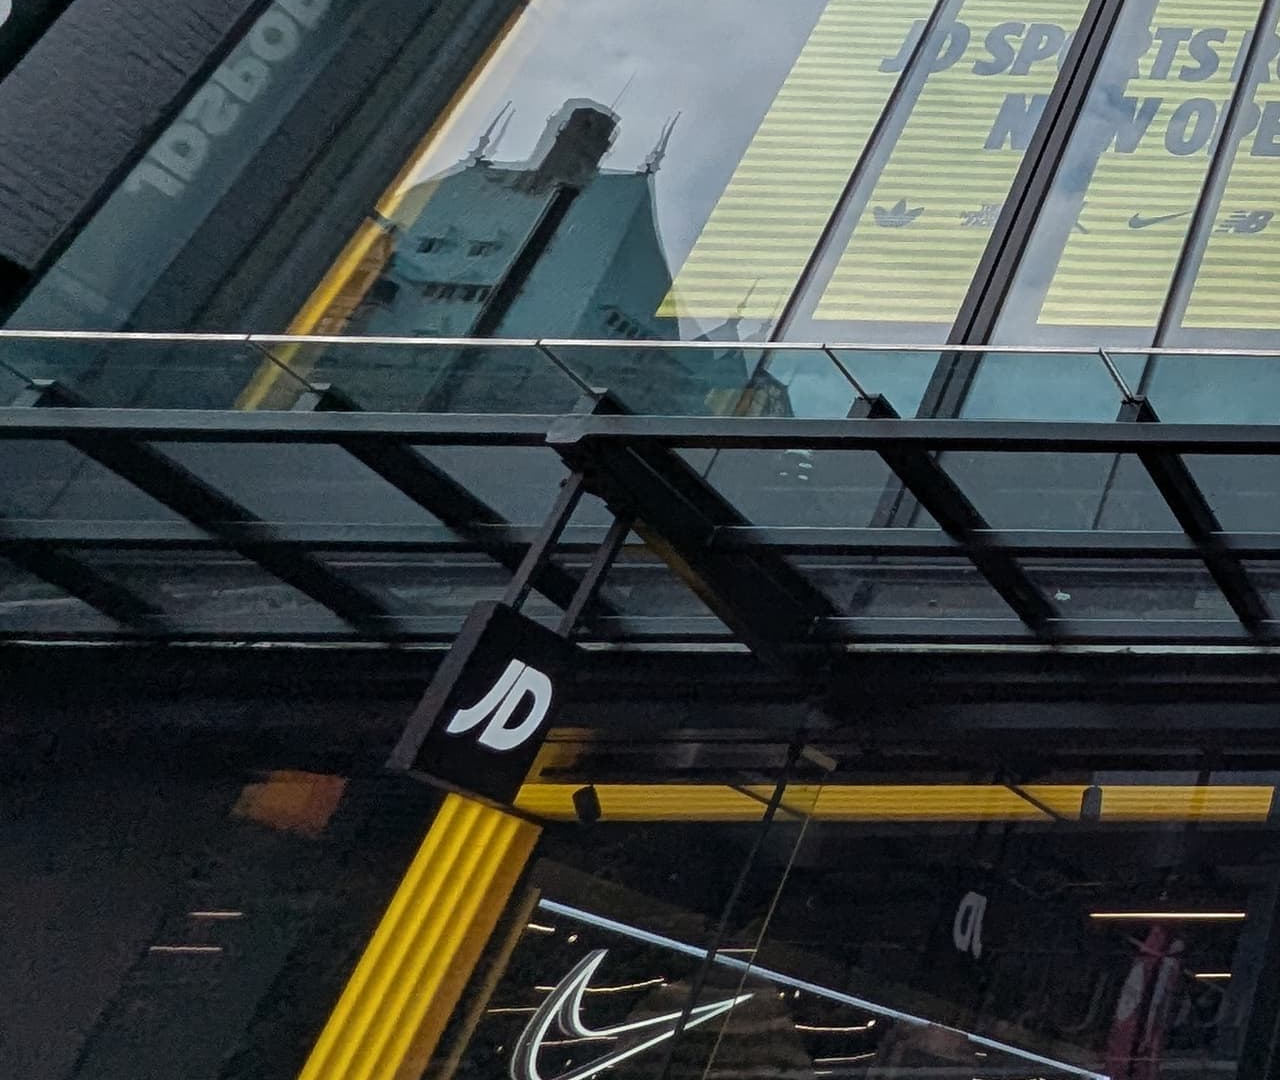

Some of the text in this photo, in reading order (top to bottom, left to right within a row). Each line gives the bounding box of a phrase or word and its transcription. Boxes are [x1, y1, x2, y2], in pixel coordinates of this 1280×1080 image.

[973, 22, 1227, 82] SPTS
[984, 93, 1163, 154] NW
[446, 658, 553, 751] JD
